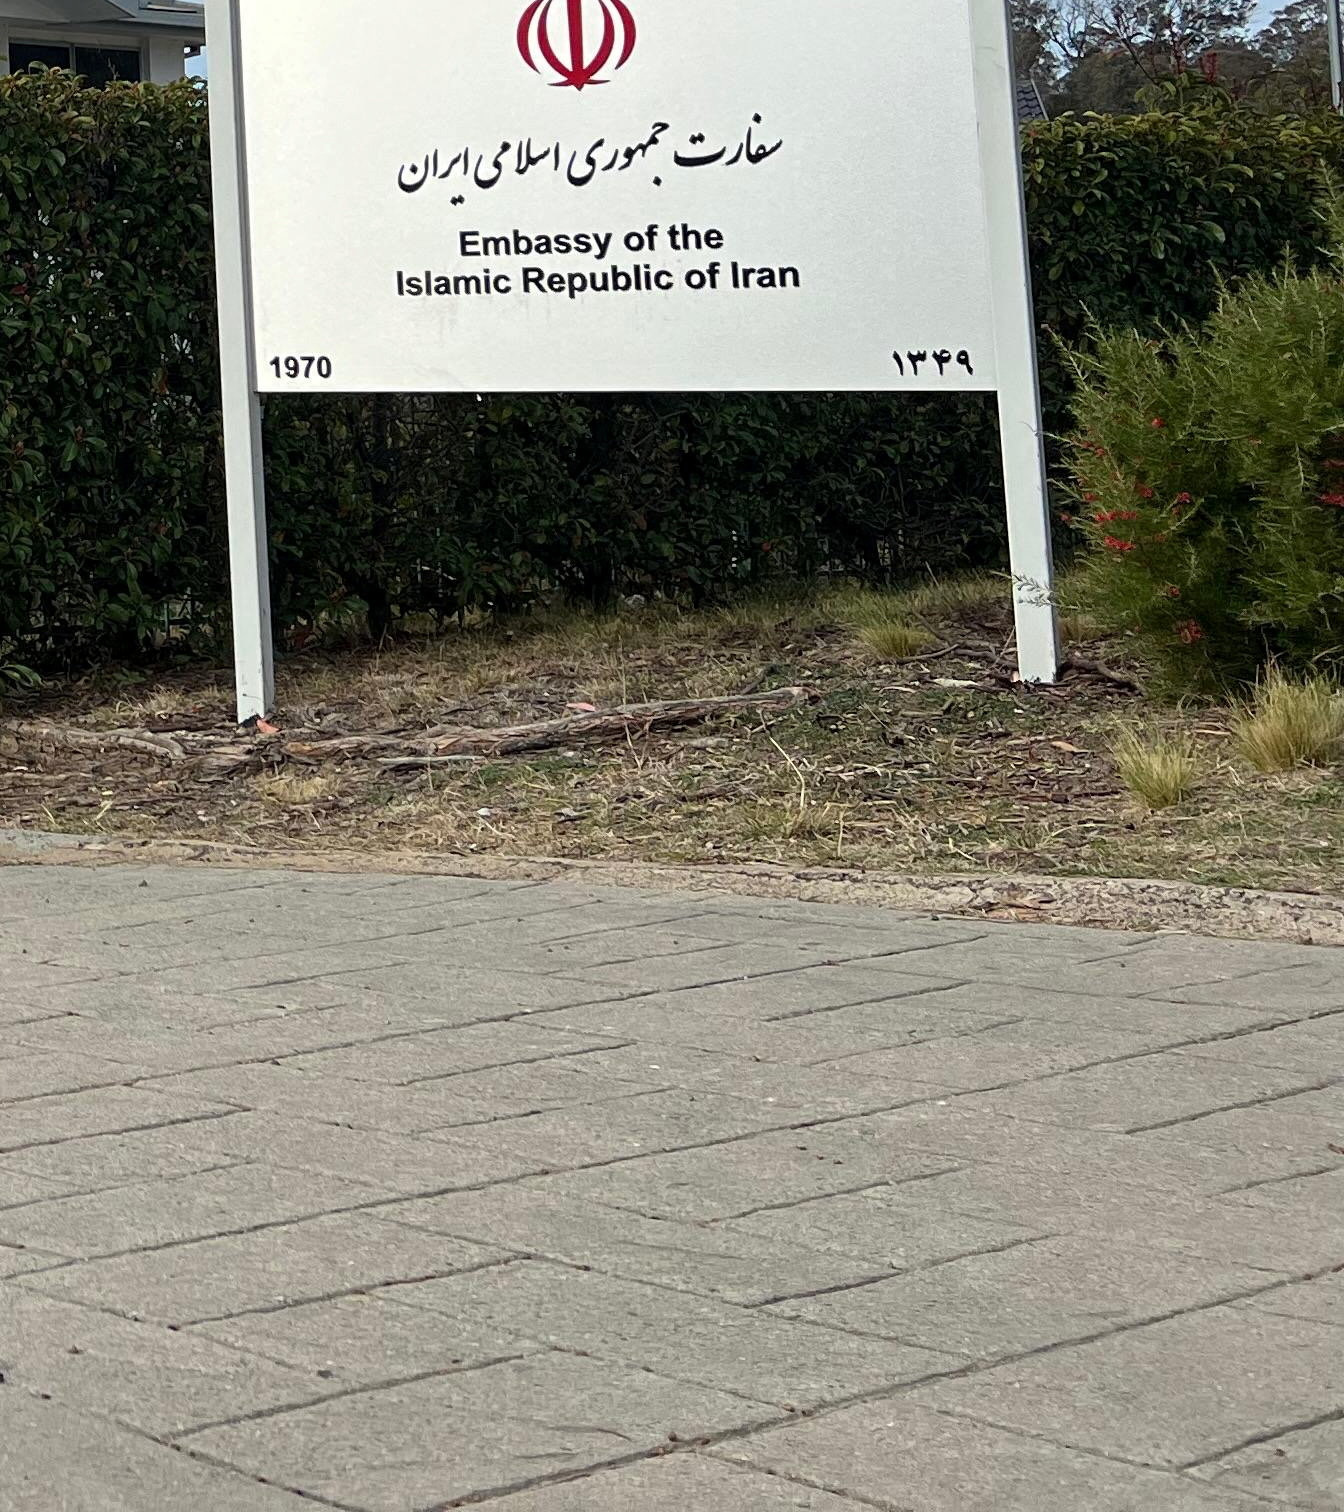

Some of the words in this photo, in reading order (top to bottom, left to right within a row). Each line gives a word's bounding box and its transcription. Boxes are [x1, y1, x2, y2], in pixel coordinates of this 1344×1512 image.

[566, 121, 670, 187] جمهوری
[673, 112, 783, 168] سفارت
[397, 147, 469, 207] ایران
[473, 137, 560, 190] اسلامی
[459, 229, 613, 260] Embassy
[623, 224, 659, 252] of
[666, 223, 724, 251] the
[396, 268, 512, 296] Islamic
[522, 264, 674, 300] Republic
[684, 262, 721, 290] of
[730, 261, 800, 289] Iran
[269, 355, 332, 379] 1970
[892, 349, 974, 377] ۱۳۴۹
